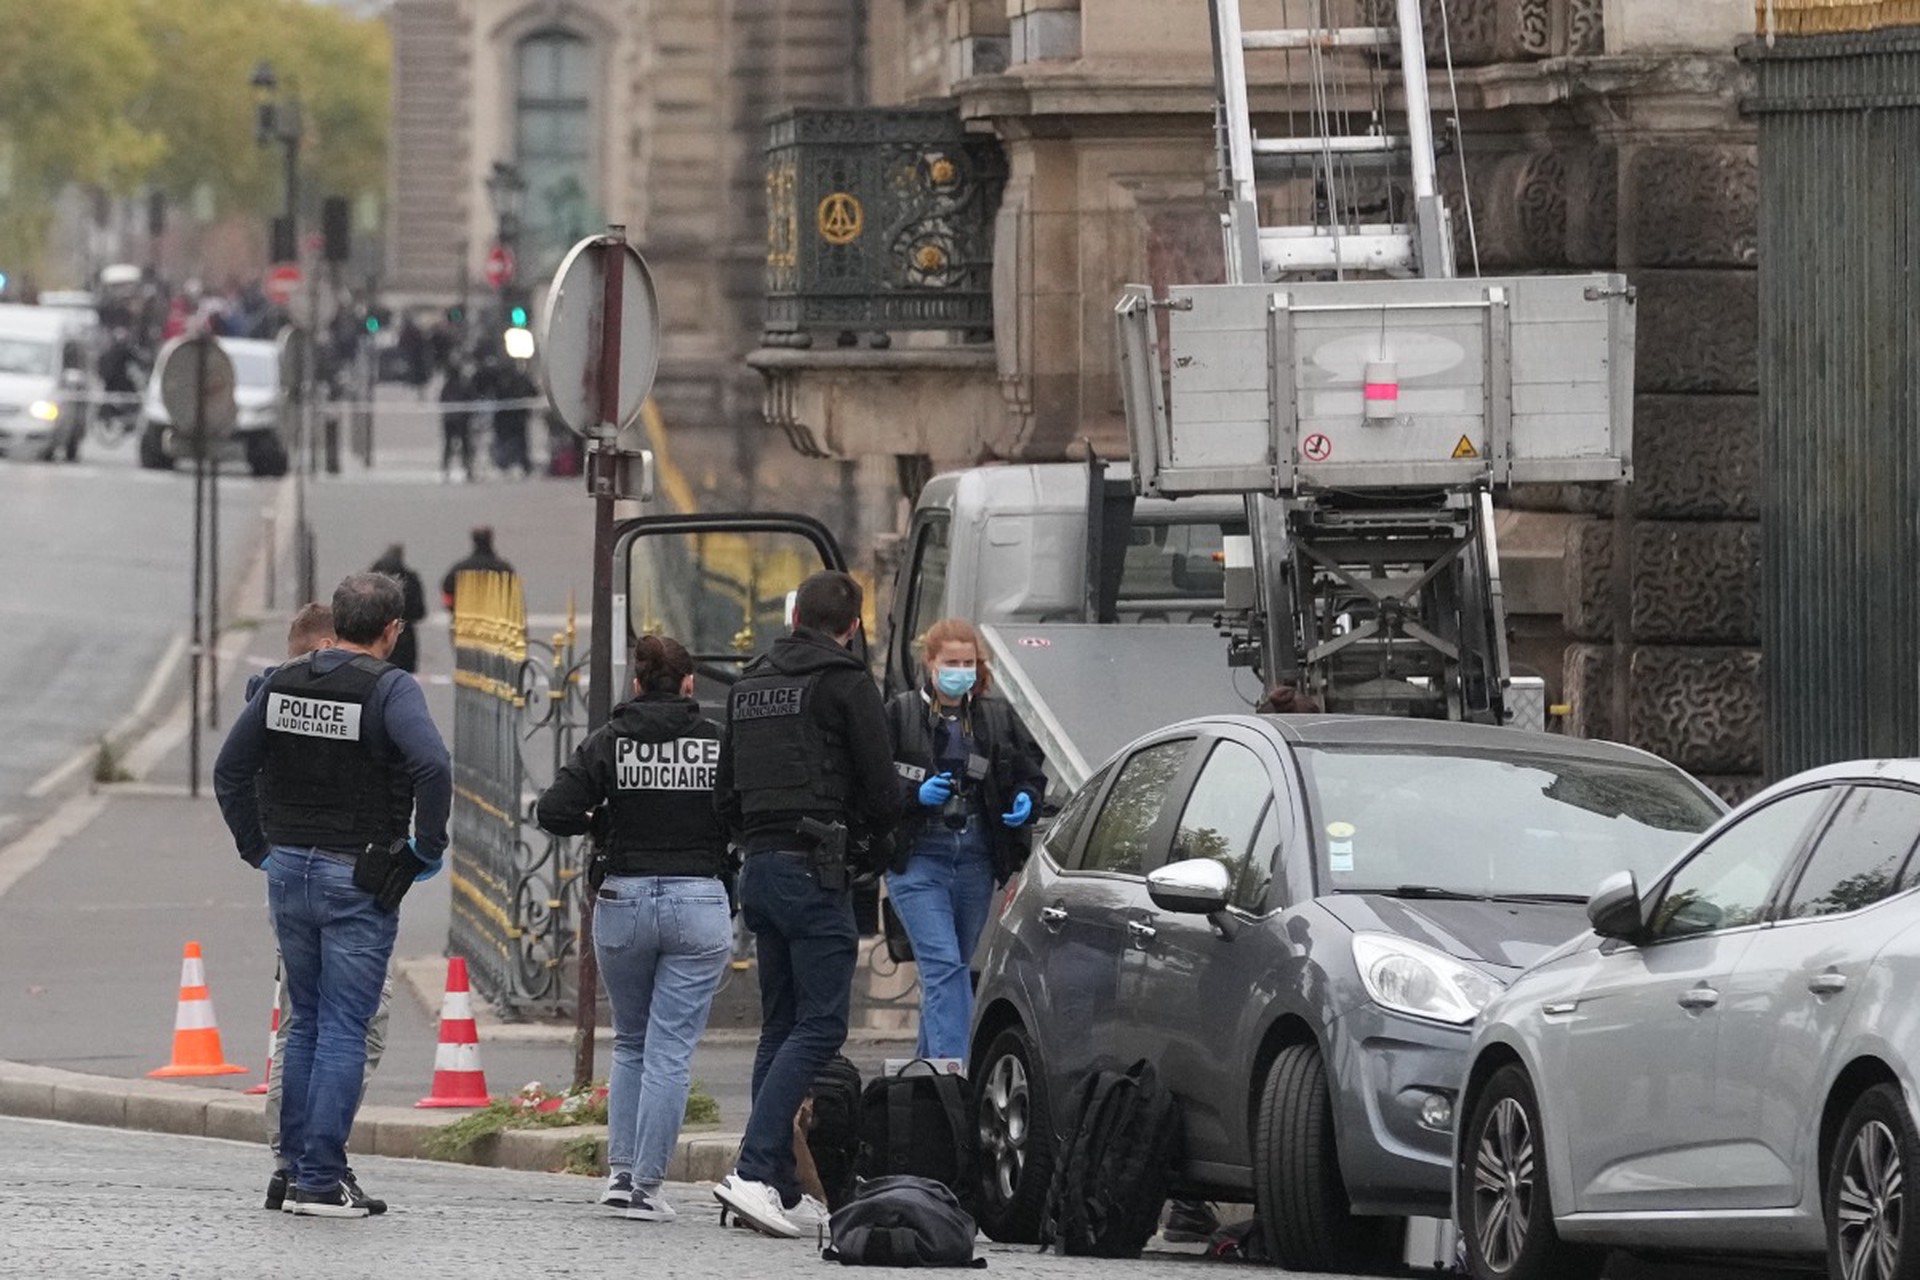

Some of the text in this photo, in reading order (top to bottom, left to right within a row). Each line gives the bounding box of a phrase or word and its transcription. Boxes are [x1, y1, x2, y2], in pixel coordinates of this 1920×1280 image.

[736, 688, 799, 709] POLICE
[279, 698, 345, 722] POLICE
[276, 717, 348, 736] JUDICIAIRE
[618, 739, 719, 764] POLICE
[619, 766, 717, 788] JUDICIAIRE
